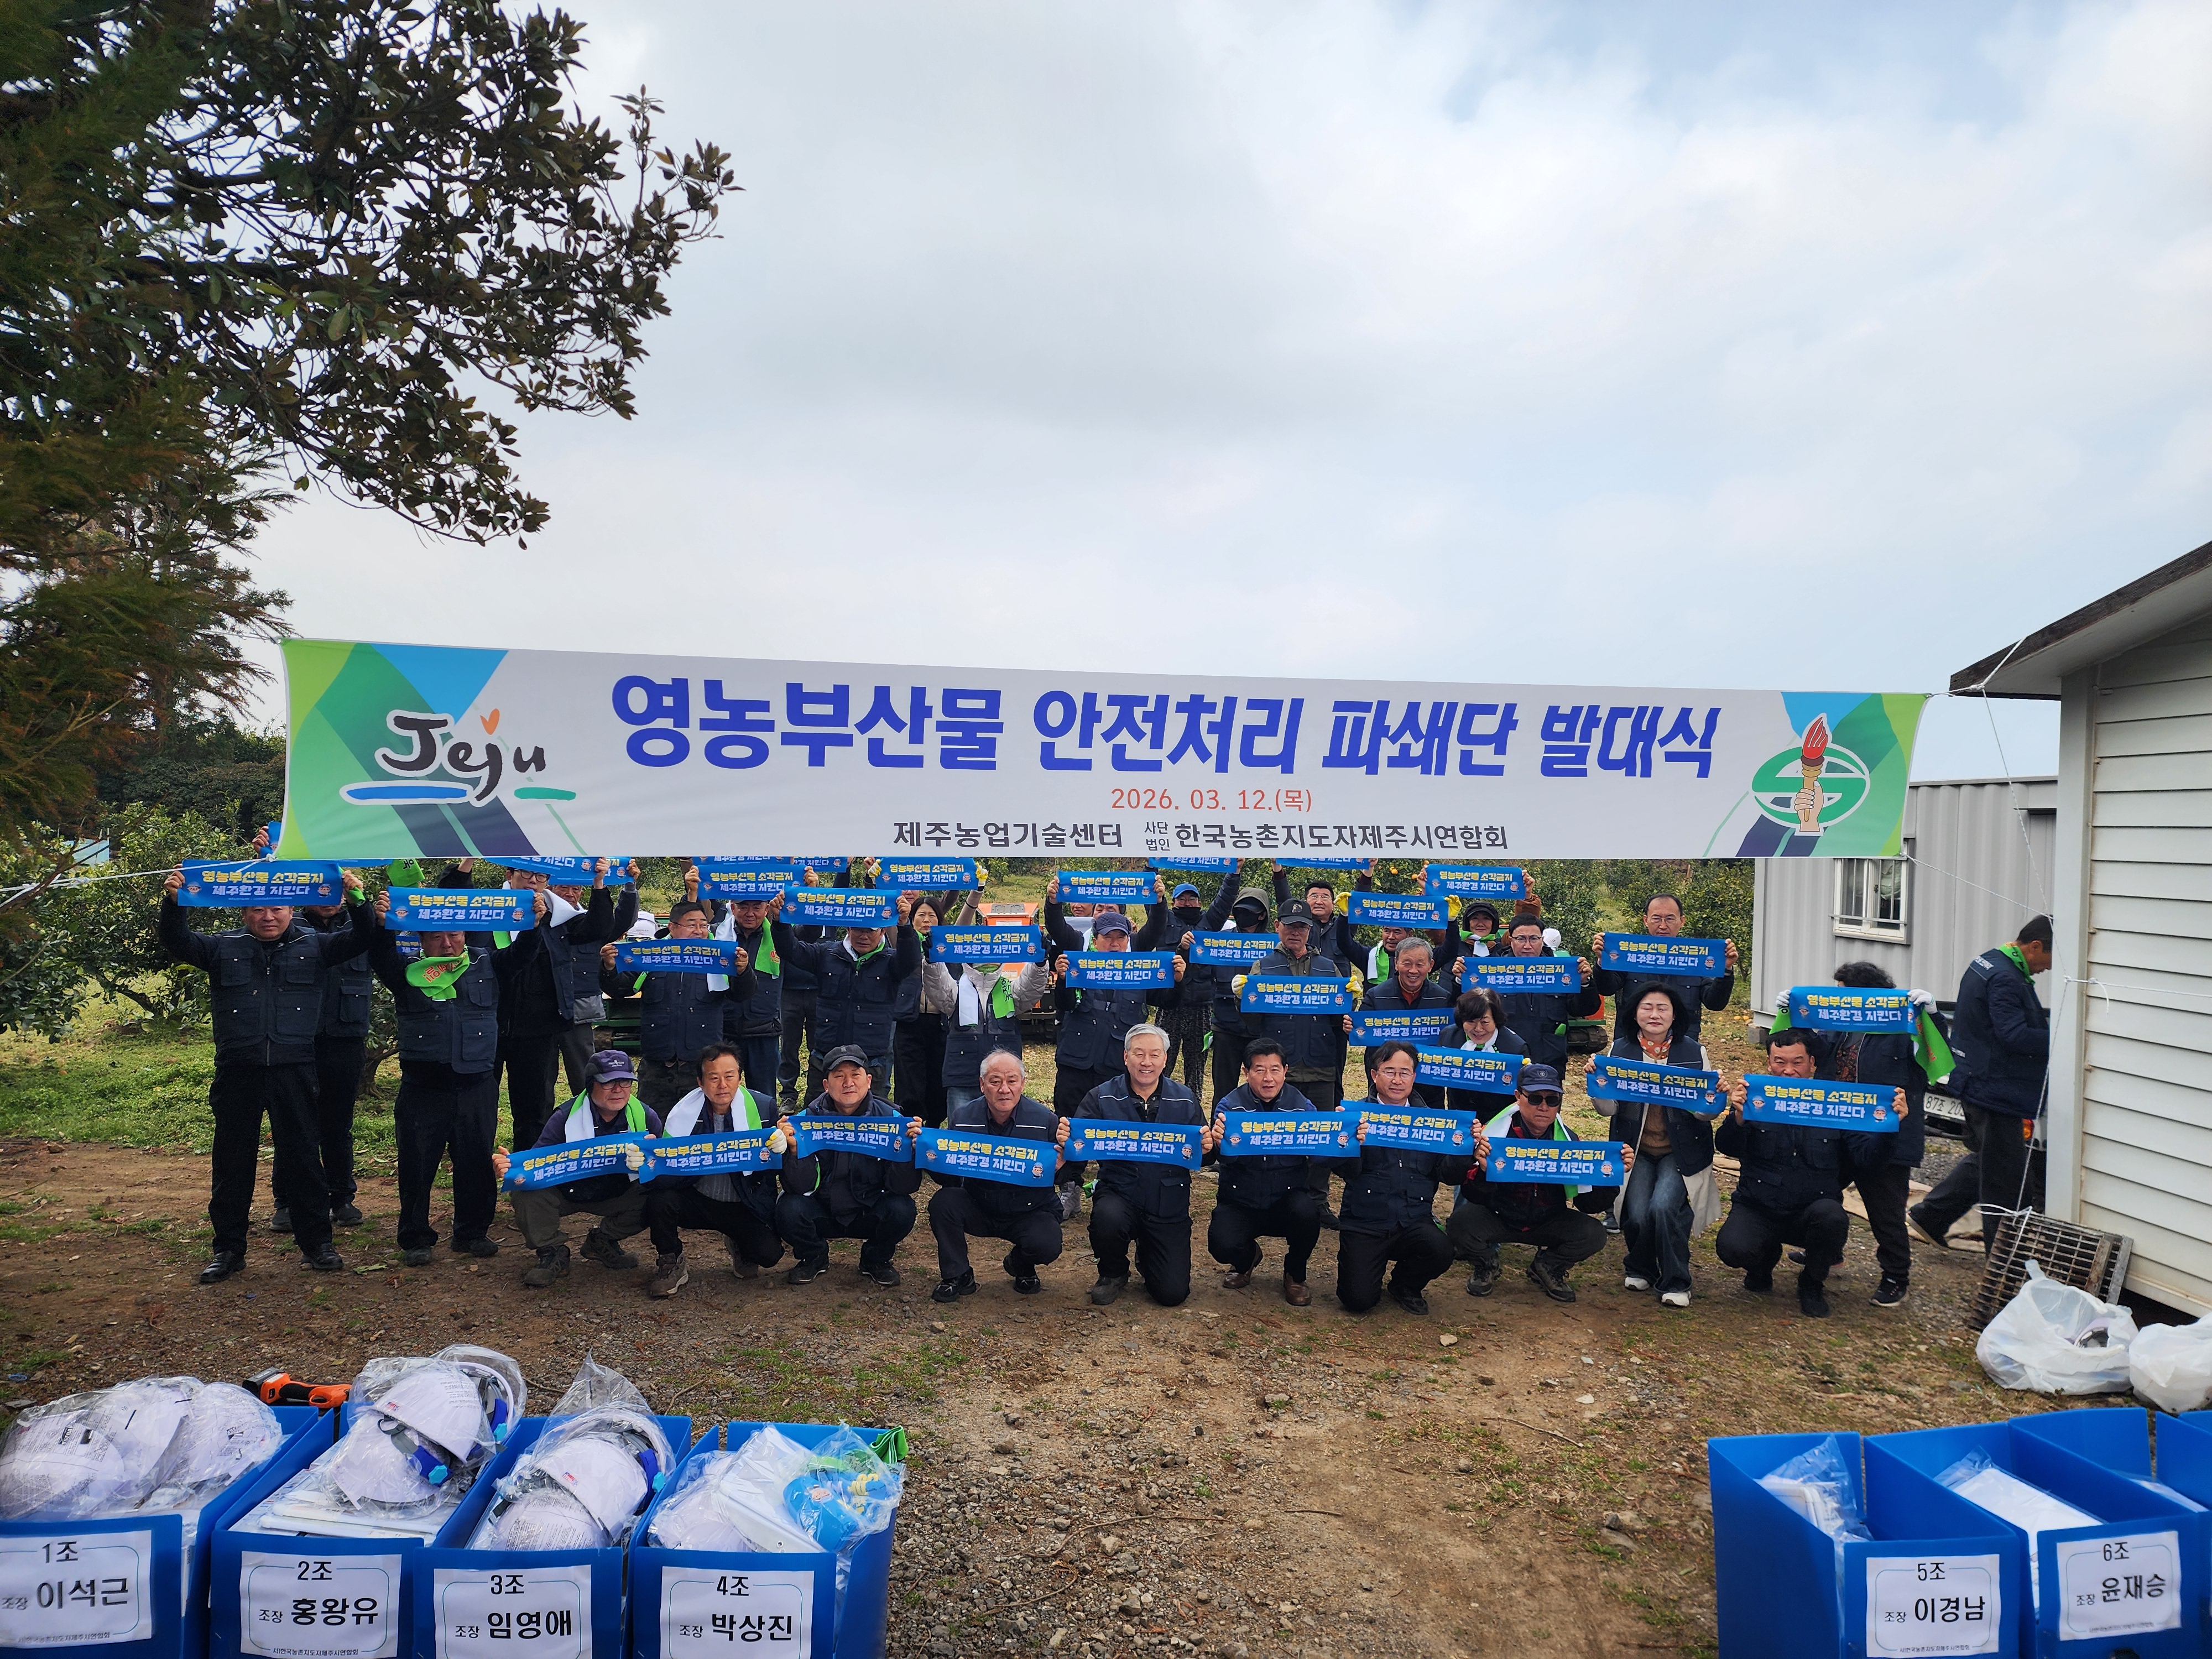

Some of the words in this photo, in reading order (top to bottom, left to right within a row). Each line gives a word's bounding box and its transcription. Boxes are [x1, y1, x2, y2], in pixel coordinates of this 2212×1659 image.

[612, 676, 1004, 770] 영농부산물
[1034, 690, 1304, 774] 안전처리
[1322, 700, 1518, 776] 파쇄단
[1541, 705, 1720, 778] 발대식
[382, 712, 546, 801] Jeju
[1112, 788, 1178, 810] 2026.
[1191, 789, 1225, 810] 03.
[1239, 790, 1311, 811] 12.(목)
[1144, 821, 1168, 834] 사단
[893, 822, 1123, 848] 제주농업기술센터
[1175, 823, 1508, 849] 한국농촌지도자제주시연합회
[1145, 838, 1171, 851] 법인
[890, 864, 930, 873] 영농부산물
[932, 864, 963, 873] 소각금지
[272, 872, 324, 884] 소각금지
[710, 872, 756, 881] 영농부산물
[758, 872, 792, 881] 소각금지
[897, 874, 930, 883] 제주환경
[932, 874, 958, 883] 지킨다
[1071, 877, 1110, 885] 영농부산물
[1113, 878, 1144, 886] 소각금지
[1439, 871, 1479, 880] 영농부산물
[1481, 873, 1512, 881] 소각금지
[213, 885, 265, 895] 제주환경
[270, 886, 309, 895] 지킨다
[720, 883, 756, 892] 제주환경
[1077, 886, 1110, 895] 제주환경
[1112, 887, 1136, 895] 지킨다
[1446, 881, 1478, 890] 제주환경
[1479, 881, 1506, 891] 지킨다
[408, 895, 468, 906] 영농부산물
[470, 896, 516, 907] 소각금지
[797, 893, 846, 904] 영농부산물
[847, 895, 885, 905] 소각금지
[1362, 899, 1401, 909] 영농부산물
[1403, 902, 1434, 911] 소각금지
[418, 909, 465, 920] 제주환경
[469, 910, 505, 920] 지킨다
[805, 905, 843, 916] 제주환경
[846, 907, 876, 917] 지킨다
[1369, 909, 1401, 920] 제주환경
[1402, 910, 1427, 920] 지킨다
[945, 933, 991, 943] 영농부산물
[993, 933, 1029, 943] 소각금지
[1203, 938, 1241, 948] 영농부산물
[1243, 941, 1274, 949] 소각금지
[631, 946, 681, 954] 영농부산물
[684, 946, 720, 956] 소각금지
[954, 945, 990, 954] 제주환경
[993, 945, 1021, 954] 지킨다
[1210, 948, 1240, 958] 제주환경
[1619, 941, 1667, 953] 영농부산물
[1670, 945, 1708, 955] 소각금지
[684, 956, 712, 964] 지킨다
[1078, 959, 1123, 969] 영농부산물
[1125, 959, 1160, 969] 소각금지
[1627, 953, 1666, 965] 제주환경
[1668, 956, 1698, 967] 지킨다
[1087, 971, 1122, 980] 제주환경
[1124, 971, 1152, 980] 지킨다
[1478, 965, 1525, 974] 영농부산물
[1527, 965, 1564, 973] 소각금지
[1487, 975, 1524, 984] 제주환경
[1527, 975, 1555, 984] 지킨다
[1257, 983, 1301, 993] 영농부산물
[1303, 984, 1338, 994] 소각금지
[1265, 994, 1300, 1005] 제주환경
[1302, 995, 1329, 1005] 지킨다
[1807, 995, 1862, 1008] 영농부산물
[1364, 1017, 1410, 1026] 영농부산물
[1413, 1016, 1448, 1025] 소각금지
[1818, 1009, 1863, 1021] 제주환경
[1865, 1010, 1902, 1021] 지킨다
[1373, 1027, 1410, 1037] 제주환경
[1412, 1027, 1441, 1036] 지킨다
[1464, 1058, 1506, 1071] 소각금지
[1421, 1065, 1460, 1078] 제주환경
[1464, 1070, 1495, 1082] 지킨다
[1606, 1066, 1660, 1083] 영농부산물
[1663, 1074, 1707, 1089] 소각금지
[1617, 1079, 1660, 1094] 제주환경
[1663, 1086, 1698, 1099] 지킨다
[1764, 1085, 1825, 1101] 영농부산물
[1827, 1091, 1877, 1105] 소각금지
[1775, 1100, 1823, 1115] 제주환경
[1827, 1105, 1865, 1118] 지킨다
[800, 1121, 855, 1130] 영농부산물
[857, 1123, 899, 1134] 소각금지
[1241, 1121, 1296, 1133] 영농부산물
[1298, 1121, 1342, 1132] 소각금지
[1413, 1117, 1457, 1129] 소각금지
[812, 1131, 855, 1141] 제주환경
[858, 1133, 889, 1146] 지킨다
[1084, 1129, 1139, 1140] 영농부산물
[1141, 1132, 1186, 1142] 소각금지
[1250, 1134, 1293, 1145] 제주환경
[1296, 1134, 1331, 1144] 지킨다
[1411, 1128, 1445, 1141] 지킨다
[716, 1138, 762, 1152] 소각금지
[937, 1139, 992, 1155] 영농부산물
[994, 1145, 1037, 1161] 소각금지
[1093, 1140, 1138, 1152] 제주환경
[1141, 1142, 1175, 1154] 지킨다
[666, 1154, 713, 1167] 제주환경
[716, 1151, 752, 1163] 지킨다
[1505, 1146, 1559, 1160] 영농부산물
[1561, 1150, 1605, 1160] 소각금지
[523, 1149, 580, 1171] 영농부산물
[946, 1154, 989, 1167] 제주환경
[993, 1158, 1026, 1173] 지킨다
[533, 1161, 577, 1181] 제주환경
[581, 1157, 617, 1168] 지킨다
[1514, 1160, 1557, 1172] 제주환경
[1560, 1162, 1594, 1174] 지킨다
[42, 1541, 79, 1563] 1조
[2103, 1542, 2130, 1562] 6조
[297, 1561, 332, 1581] 2조
[1917, 1562, 1945, 1581] 5조
[491, 1574, 525, 1595] 3조
[716, 1575, 749, 1597] 4조
[2077, 1593, 2095, 1606] 조장
[2101, 1573, 2166, 1603] 윤재승
[1, 1598, 28, 1610] 조장
[36, 1578, 128, 1609] 이석근
[258, 1609, 284, 1624] 조장
[291, 1598, 378, 1626] 홍왕유
[1884, 1611, 1907, 1623] 조장
[1914, 1596, 1986, 1623] 이경남
[455, 1625, 480, 1639] 조장
[487, 1610, 571, 1640] 임영애
[679, 1624, 703, 1639] 조장
[712, 1614, 792, 1642] 박상진
